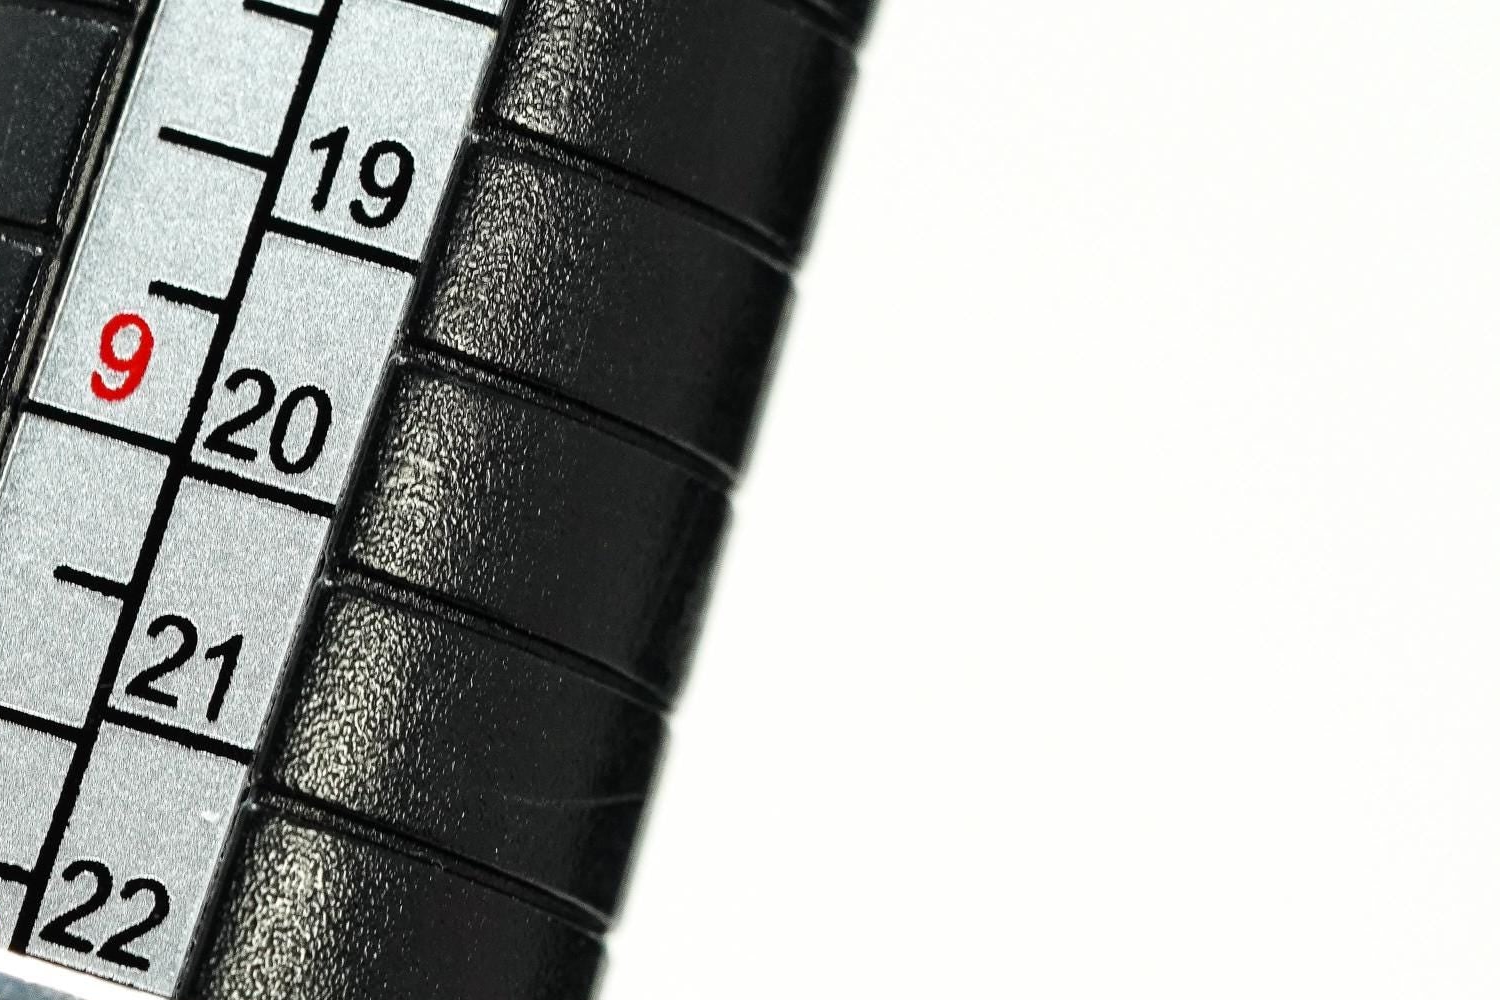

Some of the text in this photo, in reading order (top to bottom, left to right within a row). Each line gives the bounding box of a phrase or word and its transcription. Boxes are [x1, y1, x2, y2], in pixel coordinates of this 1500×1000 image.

[309, 126, 416, 230] 19
[90, 312, 155, 402] 9
[202, 367, 333, 478] 20
[124, 613, 244, 724] 21
[38, 859, 170, 972] 22
